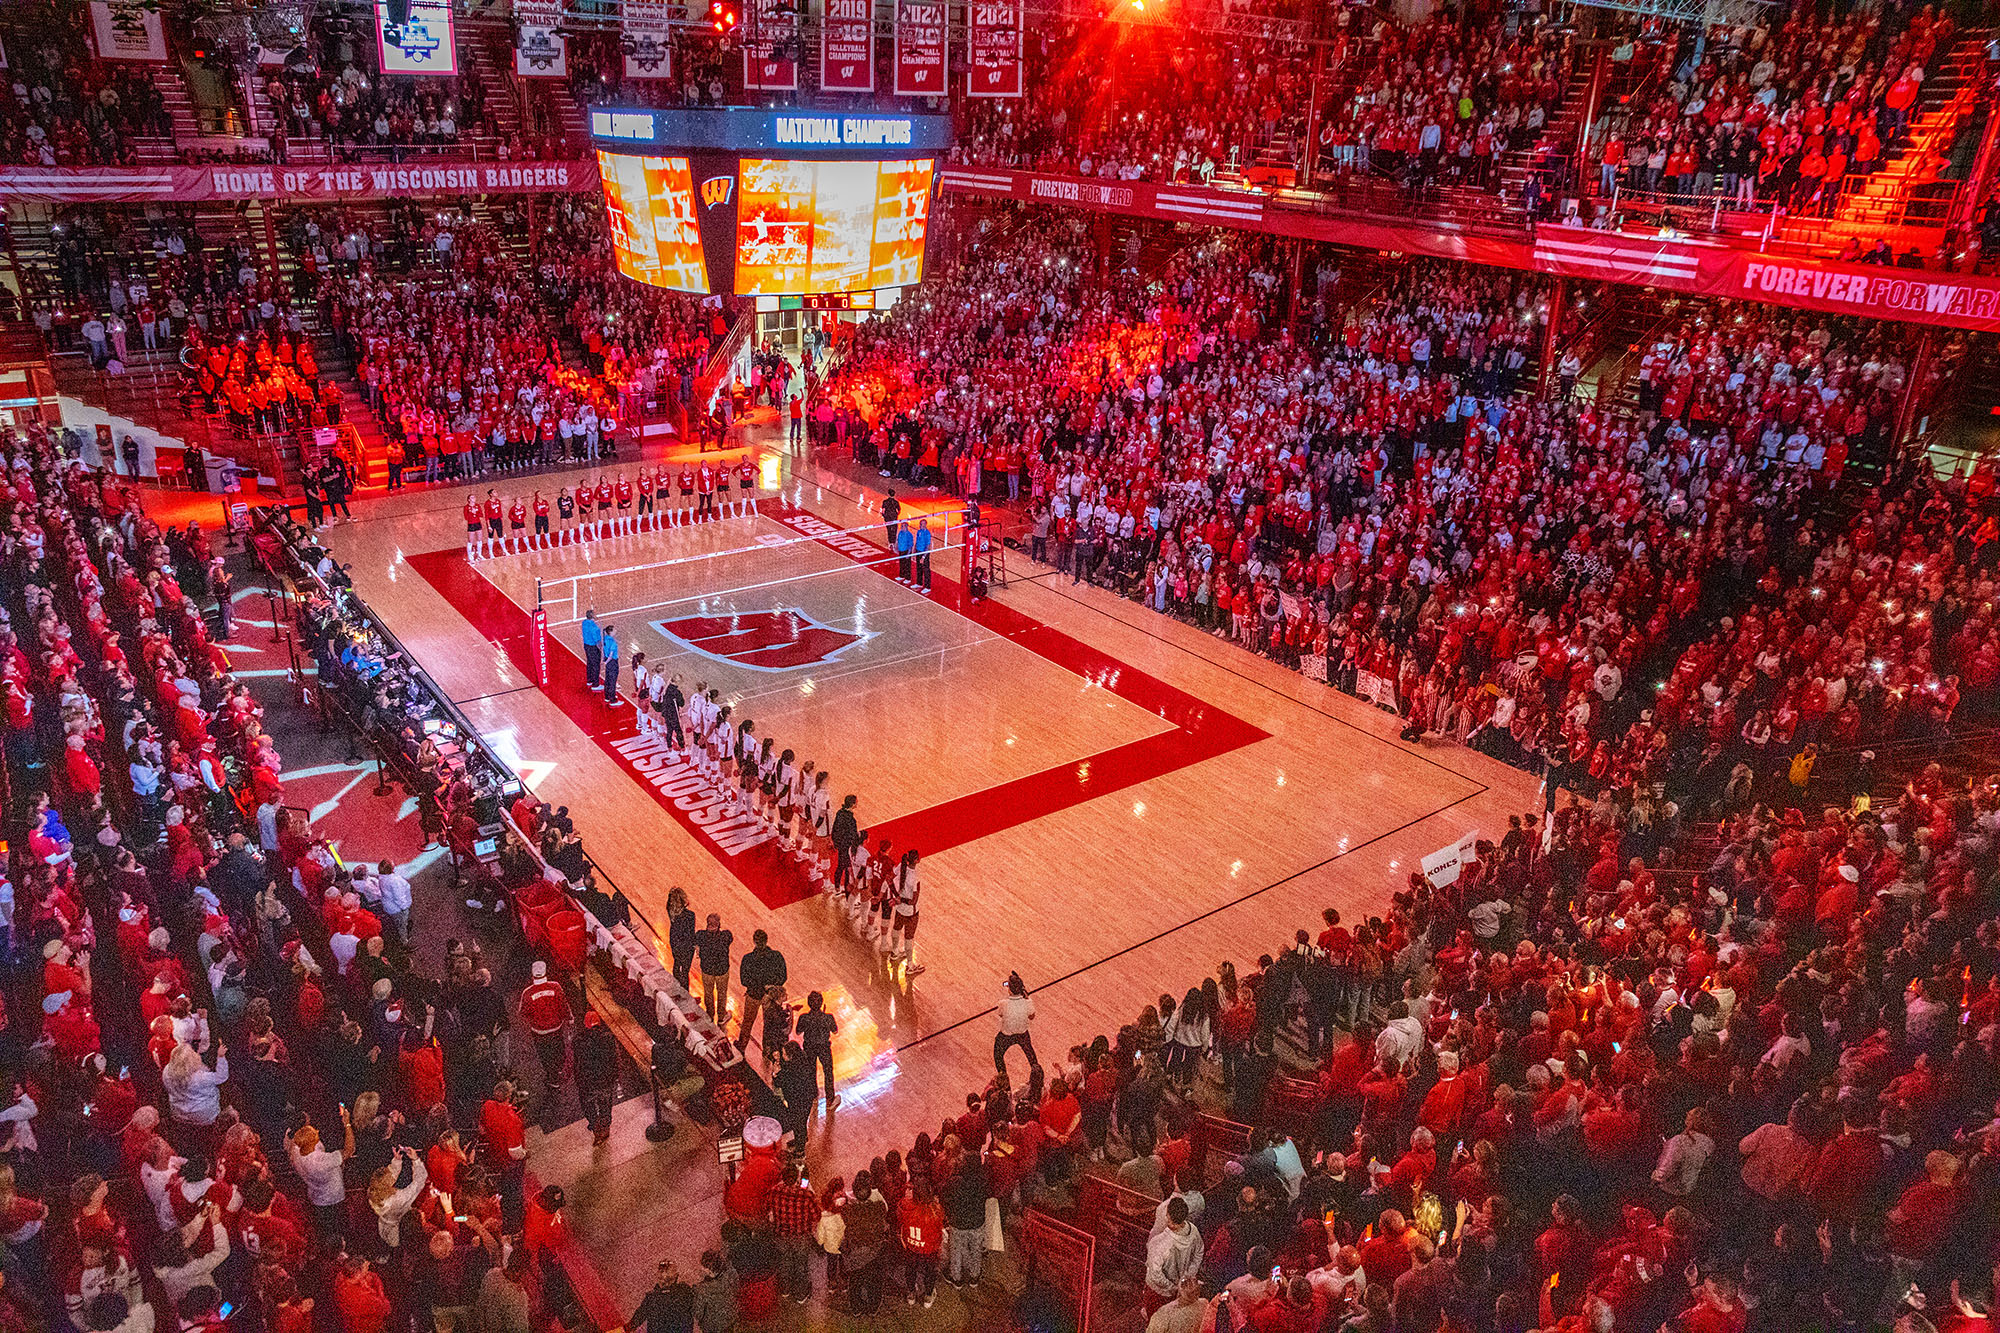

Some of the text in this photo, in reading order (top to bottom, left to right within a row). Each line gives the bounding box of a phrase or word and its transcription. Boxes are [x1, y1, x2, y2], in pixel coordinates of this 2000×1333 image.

[829, 0, 866, 18] 2019
[829, 44, 867, 52] VOLLEYBALL
[829, 52, 866, 60] CHAMPIONS
[841, 66, 854, 78] W
[914, 70, 928, 83] W
[988, 71, 1002, 84] W
[776, 118, 911, 143] NATIONAL CHAMPIONS
[213, 168, 568, 193] HOME OF THE WISCONSIN BADGERS
[1031, 179, 1133, 207] FOREVER FORWARD
[1743, 263, 1869, 304] FOREVER
[537, 623, 548, 685] WISCONSIN
[609, 734, 779, 857] WISCONSIN
